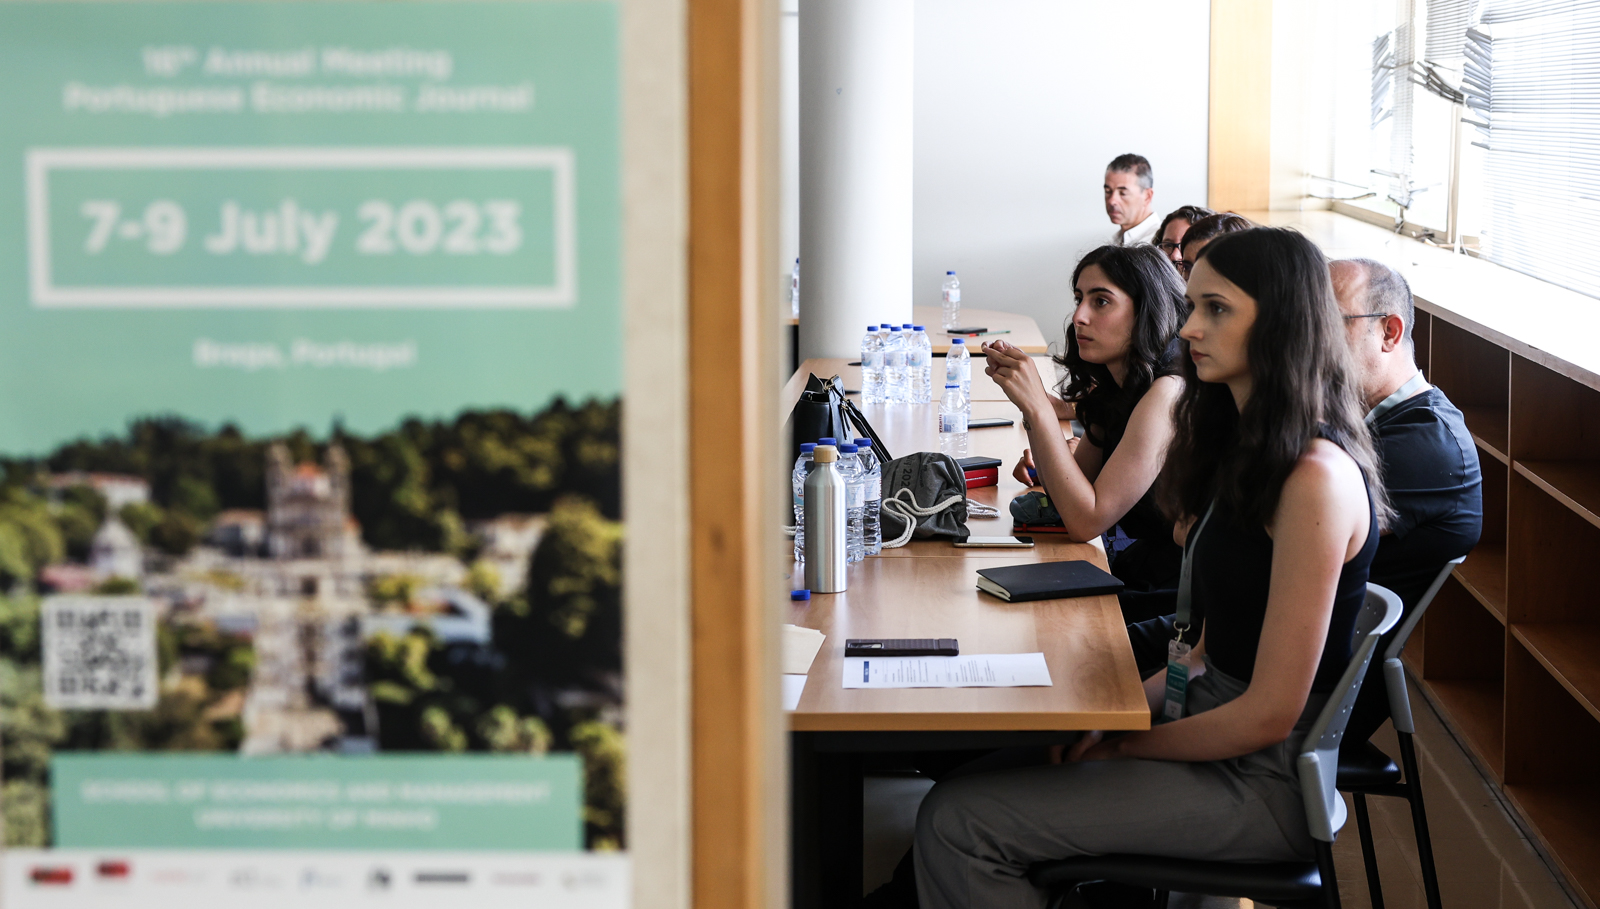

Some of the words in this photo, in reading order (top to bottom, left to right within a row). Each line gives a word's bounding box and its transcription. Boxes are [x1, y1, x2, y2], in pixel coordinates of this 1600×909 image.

[206, 50, 316, 77] Annual
[322, 48, 453, 81] Meeting
[64, 83, 243, 116] Portuguese
[251, 82, 404, 112] Economic
[416, 82, 534, 112] Journal
[82, 200, 187, 254] 7-9
[206, 199, 338, 263] July
[356, 199, 523, 255] 2023
[291, 338, 416, 370] Portugal
[900, 468, 913, 489] 202
